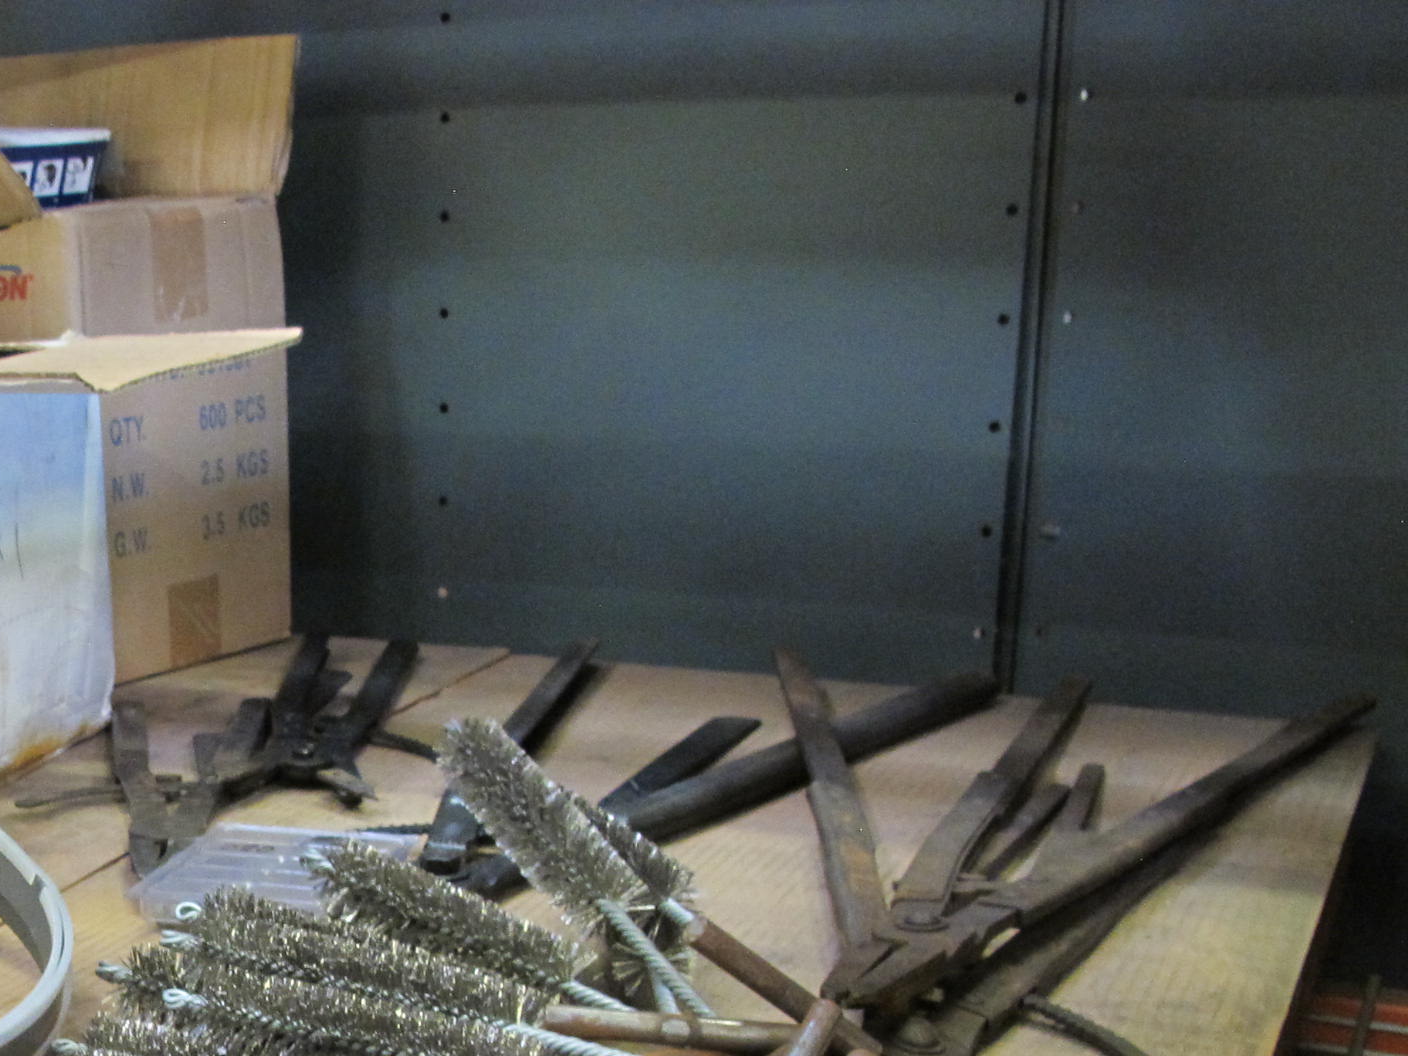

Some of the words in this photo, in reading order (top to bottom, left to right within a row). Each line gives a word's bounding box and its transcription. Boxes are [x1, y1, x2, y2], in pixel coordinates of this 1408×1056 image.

[199, 402, 227, 431] 600
[235, 394, 266, 423] PCS
[236, 449, 269, 478] KGS
[238, 501, 271, 529] KGS
